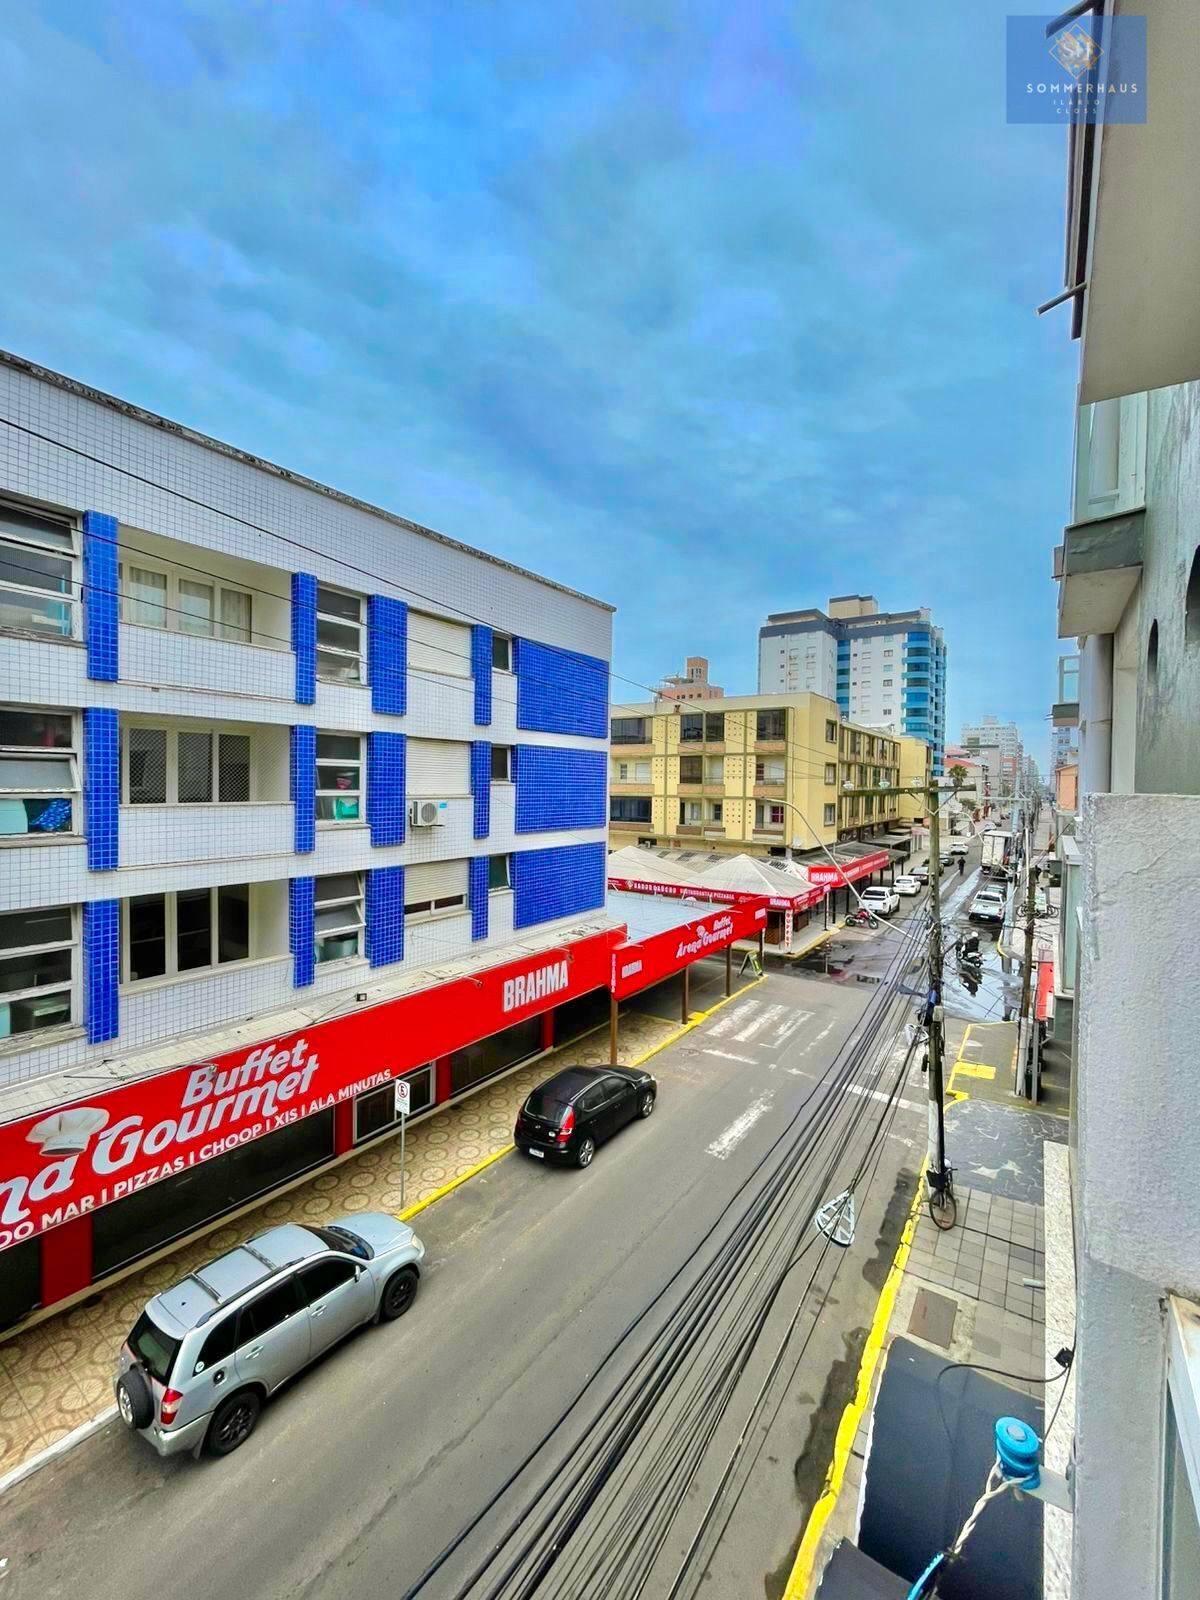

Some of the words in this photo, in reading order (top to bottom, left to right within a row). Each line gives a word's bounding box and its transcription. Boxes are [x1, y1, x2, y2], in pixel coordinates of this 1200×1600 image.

[503, 959, 569, 1013] BRAHMA
[91, 1053, 320, 1175] Gourmet
[180, 1038, 309, 1109] Buffet
[41, 1194, 95, 1230] MAR
[113, 1155, 185, 1200] PIZZAS
[199, 1122, 263, 1160] CHOOP
[273, 1107, 299, 1129] XIS
[308, 1092, 336, 1114] ALA
[338, 1068, 392, 1100] MINUTAS
